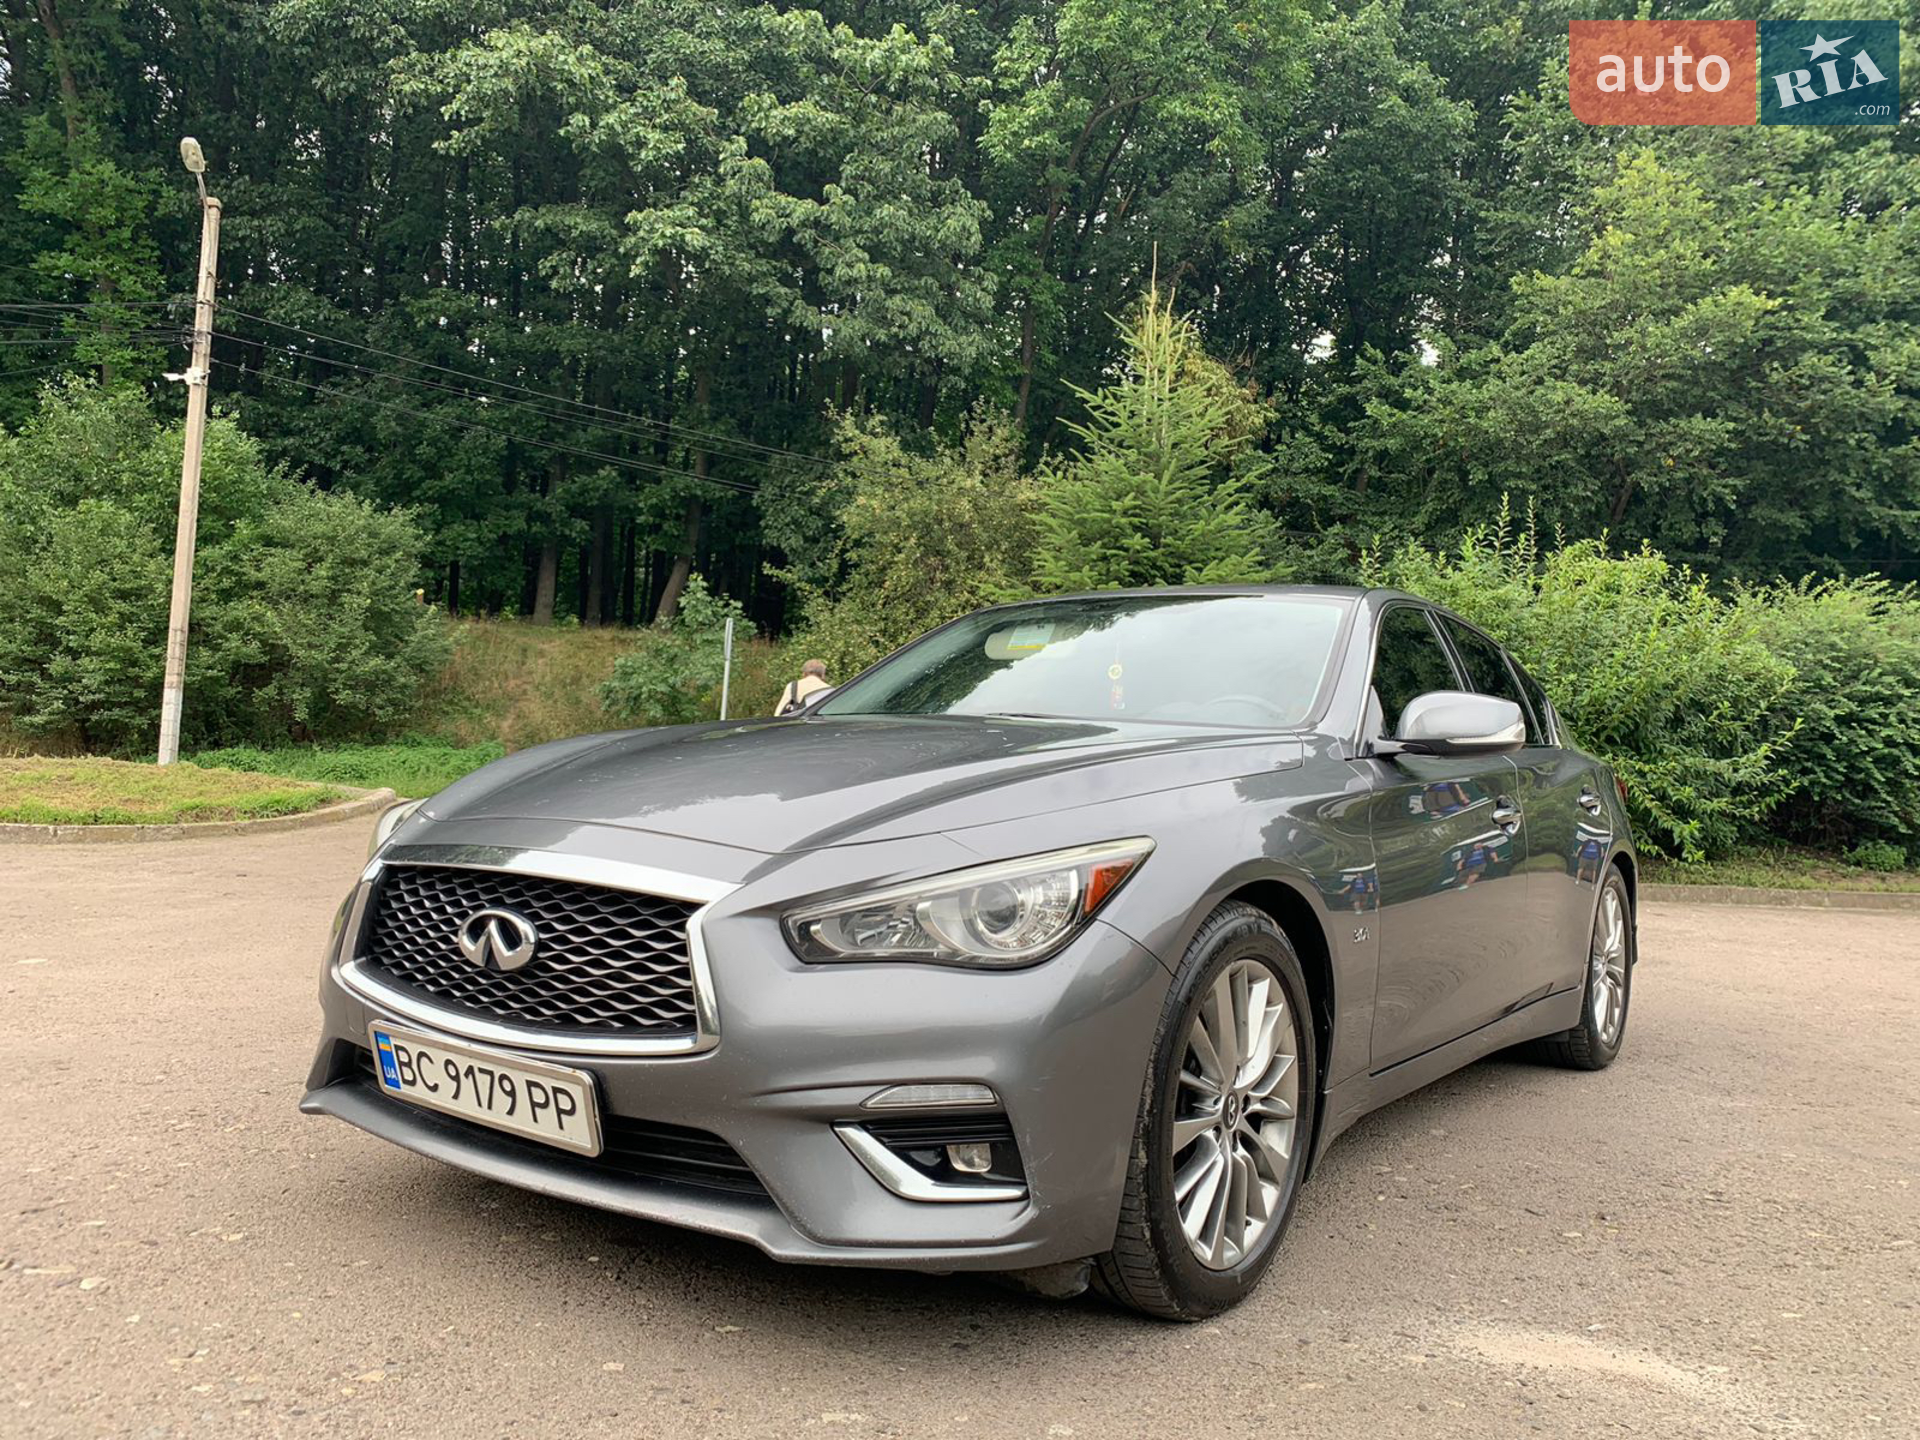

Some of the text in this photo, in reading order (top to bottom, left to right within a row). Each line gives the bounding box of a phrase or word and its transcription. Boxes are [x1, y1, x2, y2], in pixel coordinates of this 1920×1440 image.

[384, 1065, 398, 1080] UA
[394, 1044, 576, 1130] BC 9179 PP
